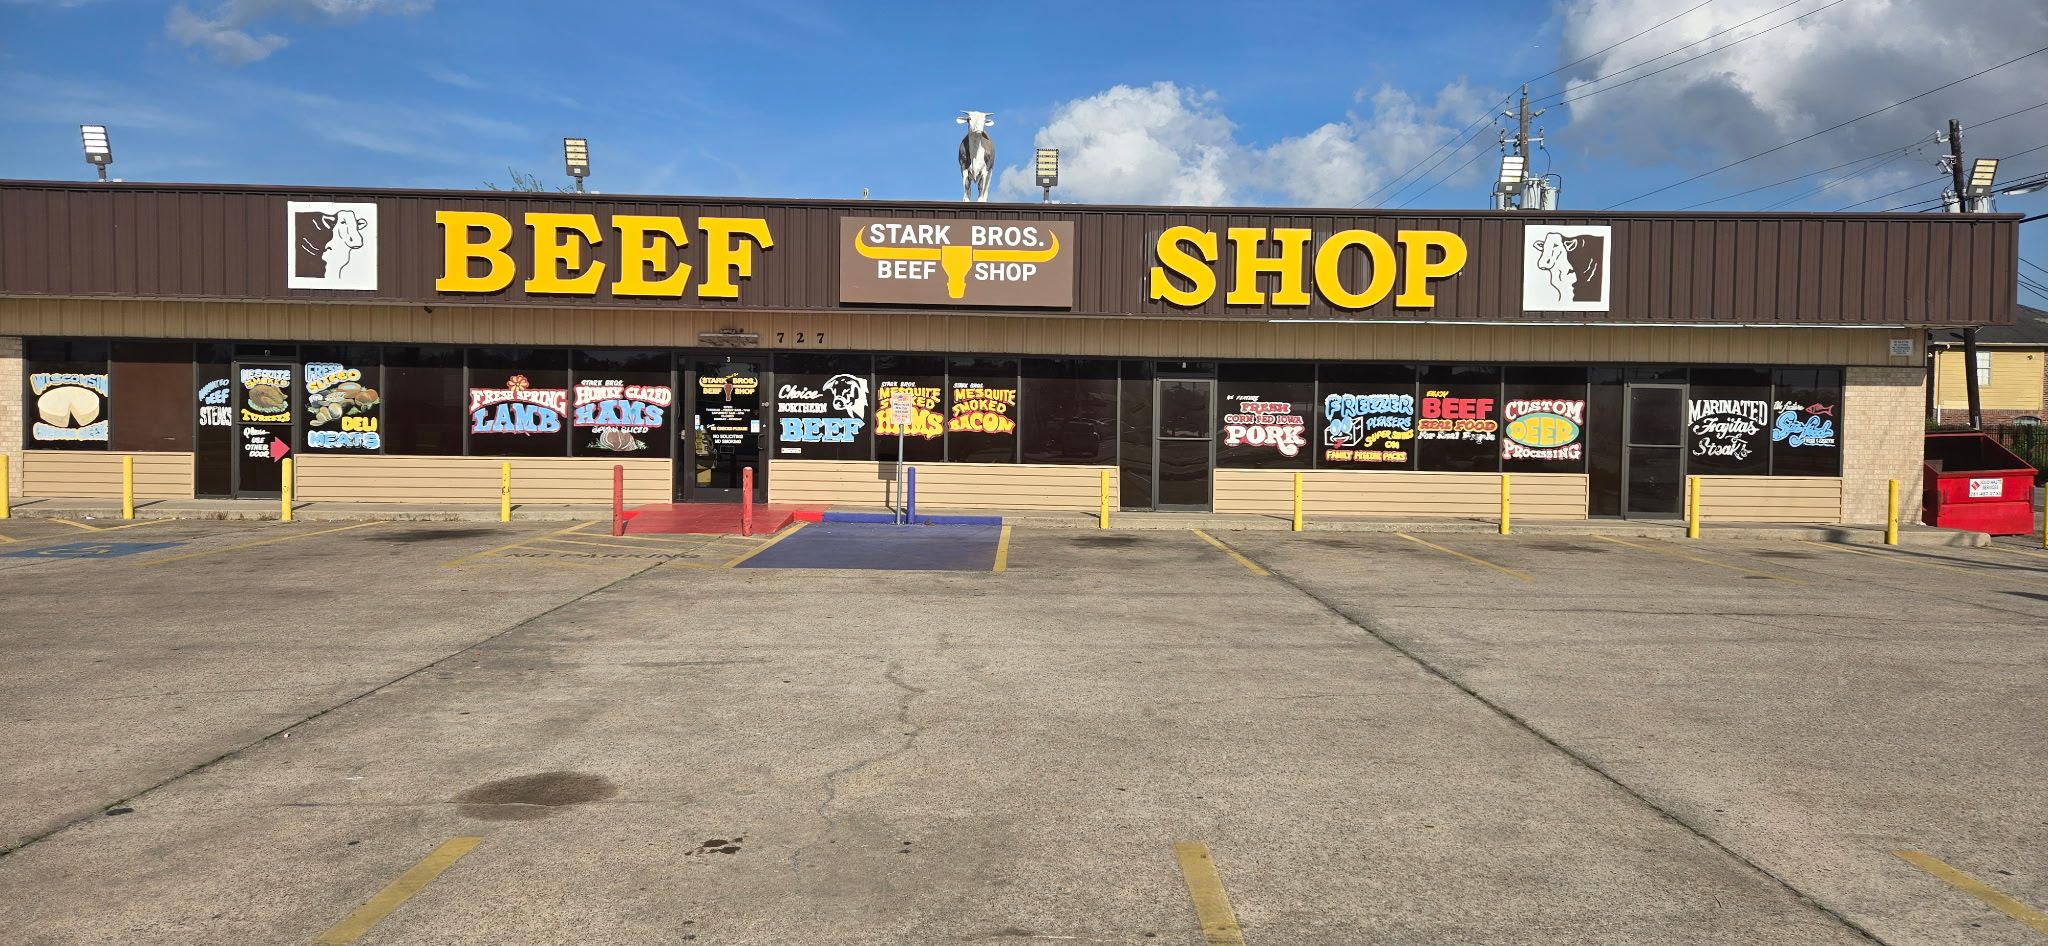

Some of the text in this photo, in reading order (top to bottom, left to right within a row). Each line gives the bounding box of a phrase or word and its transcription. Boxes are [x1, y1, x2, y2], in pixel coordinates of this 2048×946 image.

[869, 223, 1045, 247] STARK BROS.
[435, 210, 775, 298] BEEF
[877, 260, 1038, 281] BEEF SHOP
[1150, 225, 1467, 309] SHOP
[240, 369, 291, 383] MESQUITE
[305, 362, 343, 382] FRESH
[306, 369, 361, 393] SLICED
[205, 389, 230, 404] BEEF
[574, 385, 672, 407] HONEY GLAZED
[778, 384, 823, 399] Choice
[954, 388, 1016, 406] MESQUITE
[1426, 390, 1449, 398] ENJOY
[470, 388, 568, 418] FRESH SPRING
[574, 400, 664, 427] HAMS
[778, 402, 828, 413] NORTHERN
[952, 399, 1007, 416] SMOKED
[1240, 402, 1291, 416] FRESH
[1325, 394, 1414, 421] FREEZER
[1423, 398, 1494, 419] BEEF
[1504, 400, 1584, 425] CUSTOM
[1688, 399, 1768, 426] MARINATED
[199, 406, 232, 426] STEAKS
[341, 416, 378, 431] DELI
[472, 402, 561, 434] LAMB
[875, 405, 944, 440] HMS
[948, 410, 1015, 434] BACON
[1224, 414, 1304, 425] CORN FED IOWA
[1366, 417, 1412, 430] PLEASERS
[1418, 419, 1498, 432] REAL FOOD
[780, 417, 865, 443] BEEF
[1364, 430, 1391, 447] SUPER
[1462, 432, 1496, 444] People
[1510, 417, 1574, 445] DEER
[1693, 417, 1760, 439] Fajitas
[307, 430, 381, 449] MEATS
[1223, 424, 1307, 457] PORK
[1384, 441, 1400, 449] ON
[1502, 438, 1582, 460] PROCESSING
[1692, 437, 1752, 460] Steaks
[1383, 451, 1407, 462] PACKS
